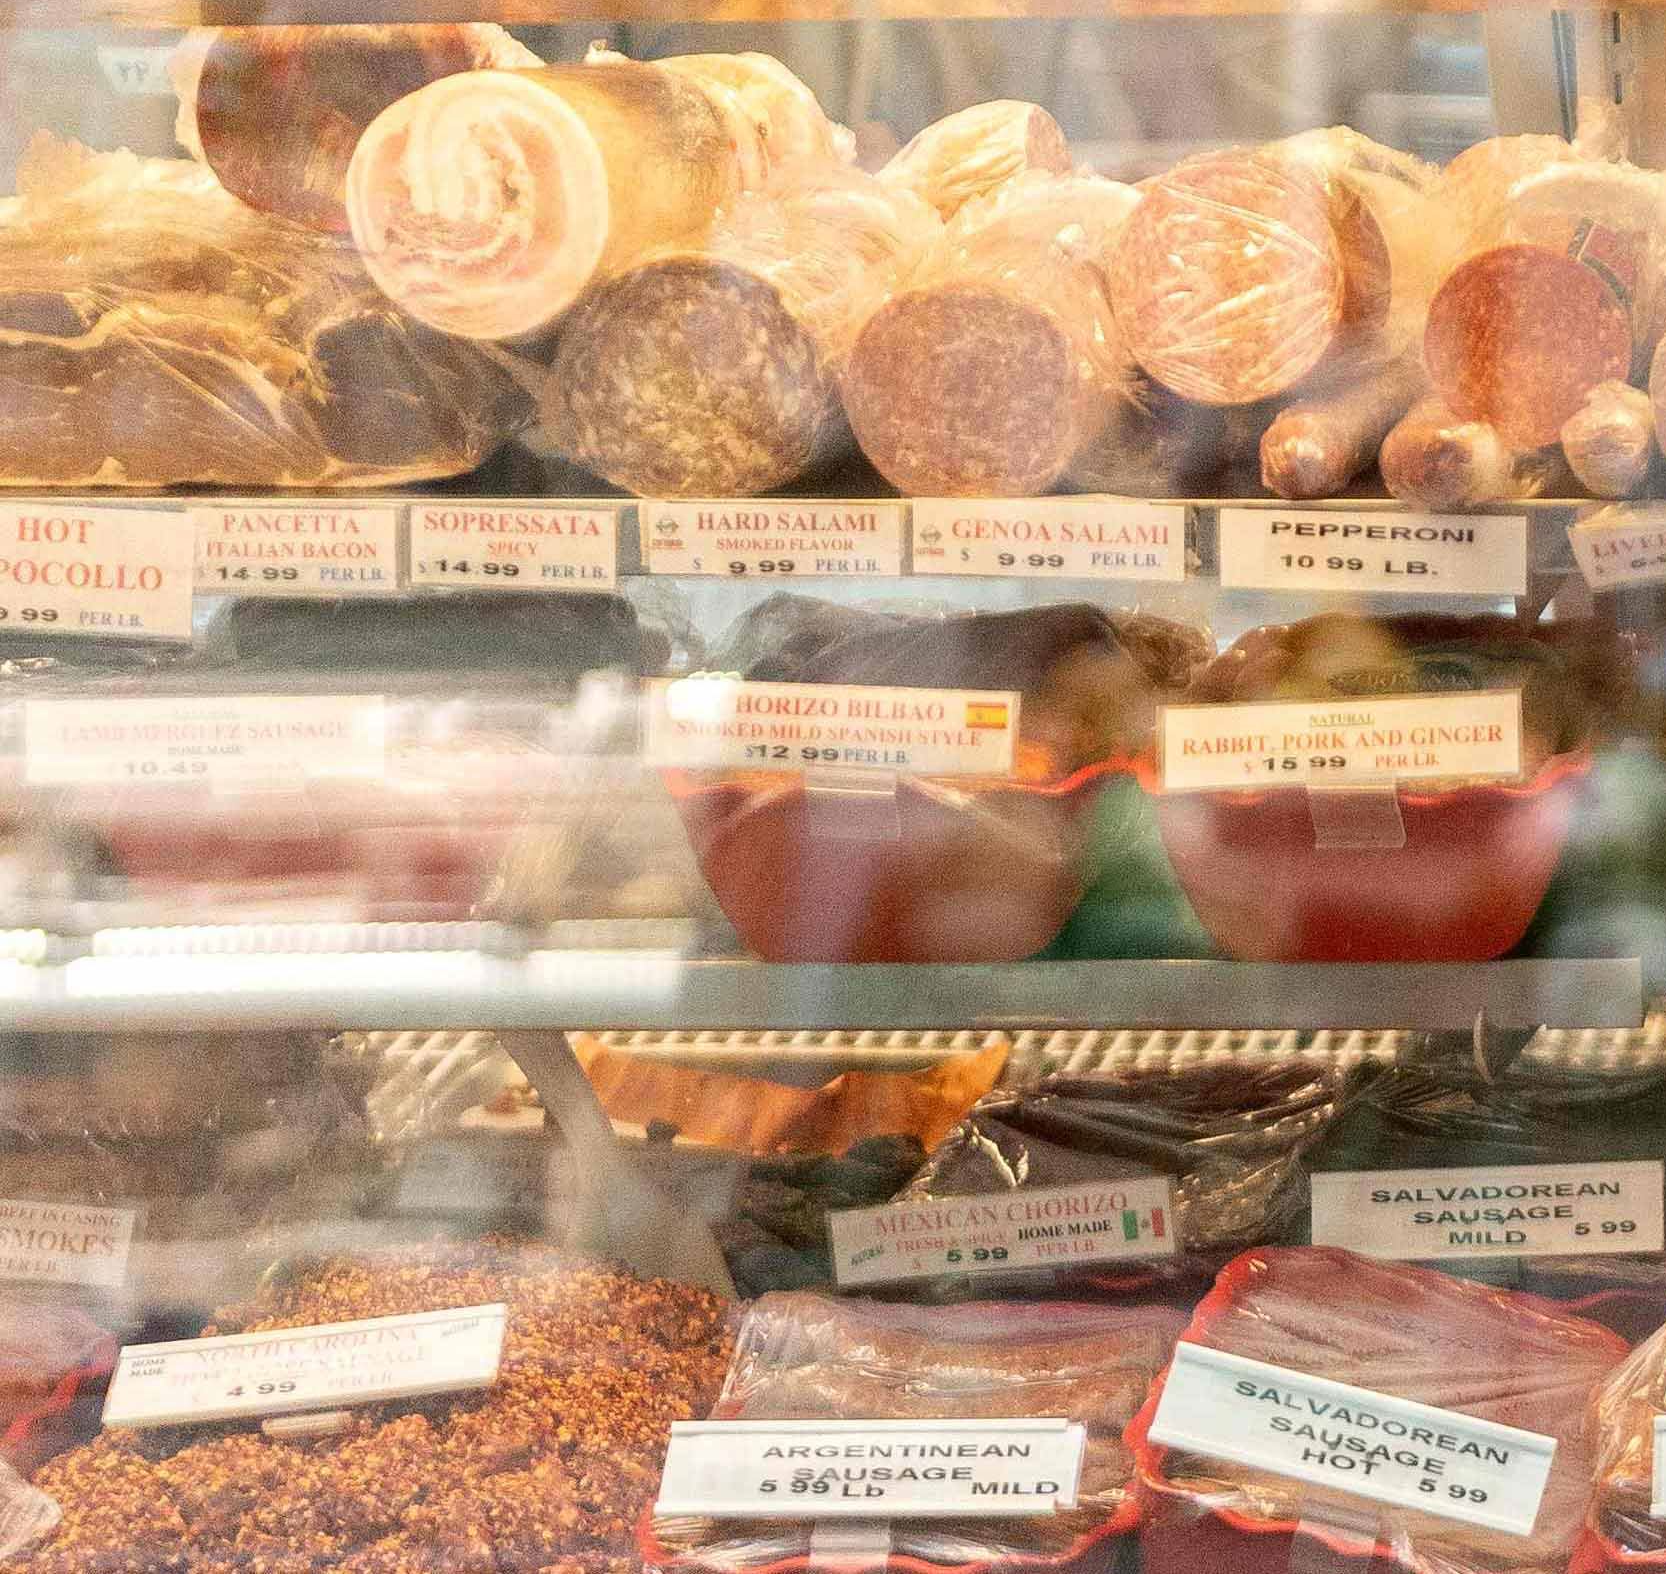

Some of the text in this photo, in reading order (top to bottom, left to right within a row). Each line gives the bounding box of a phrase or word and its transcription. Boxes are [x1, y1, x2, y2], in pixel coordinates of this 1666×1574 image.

[16, 516, 96, 545] HOT
[222, 513, 361, 534] PANCETTA
[423, 511, 601, 536] SOPRESSATA
[697, 512, 878, 532] HARD SALAMI
[951, 519, 1169, 545] GENOA SALAMI
[1269, 521, 1474, 543] PEPPERONI
[206, 541, 378, 559] ITALIAN BACON
[486, 540, 539, 556] SPICY
[715, 537, 856, 551] SMOKED FLAVOR
[847, 697, 946, 721] BILBAO
[1309, 712, 1376, 726] NATURAL
[247, 721, 350, 740] SAUSAGE
[769, 726, 983, 747] MILD SPANISH STYLE
[1181, 723, 1504, 757] RABBIT, PORK AND GINGER
[123, 760, 209, 776] 10.49
[1370, 1180, 1621, 1205] SALVADOREAN
[875, 1192, 1130, 1237] MEXICAN CHORIZO
[1413, 1204, 1574, 1225] SAUSAGE
[896, 1218, 1113, 1253] FRESH HOME MADE
[1449, 1229, 1528, 1245] MILD
[1234, 1378, 1510, 1466] SALVADOREAN
[761, 1443, 1032, 1460] ARGENTINEAN
[1268, 1414, 1446, 1475] SAUSAGE
[1302, 1447, 1381, 1477] HOT
[792, 1466, 973, 1482] SAUSAGE
[841, 1480, 1060, 1498] Lb MILD
